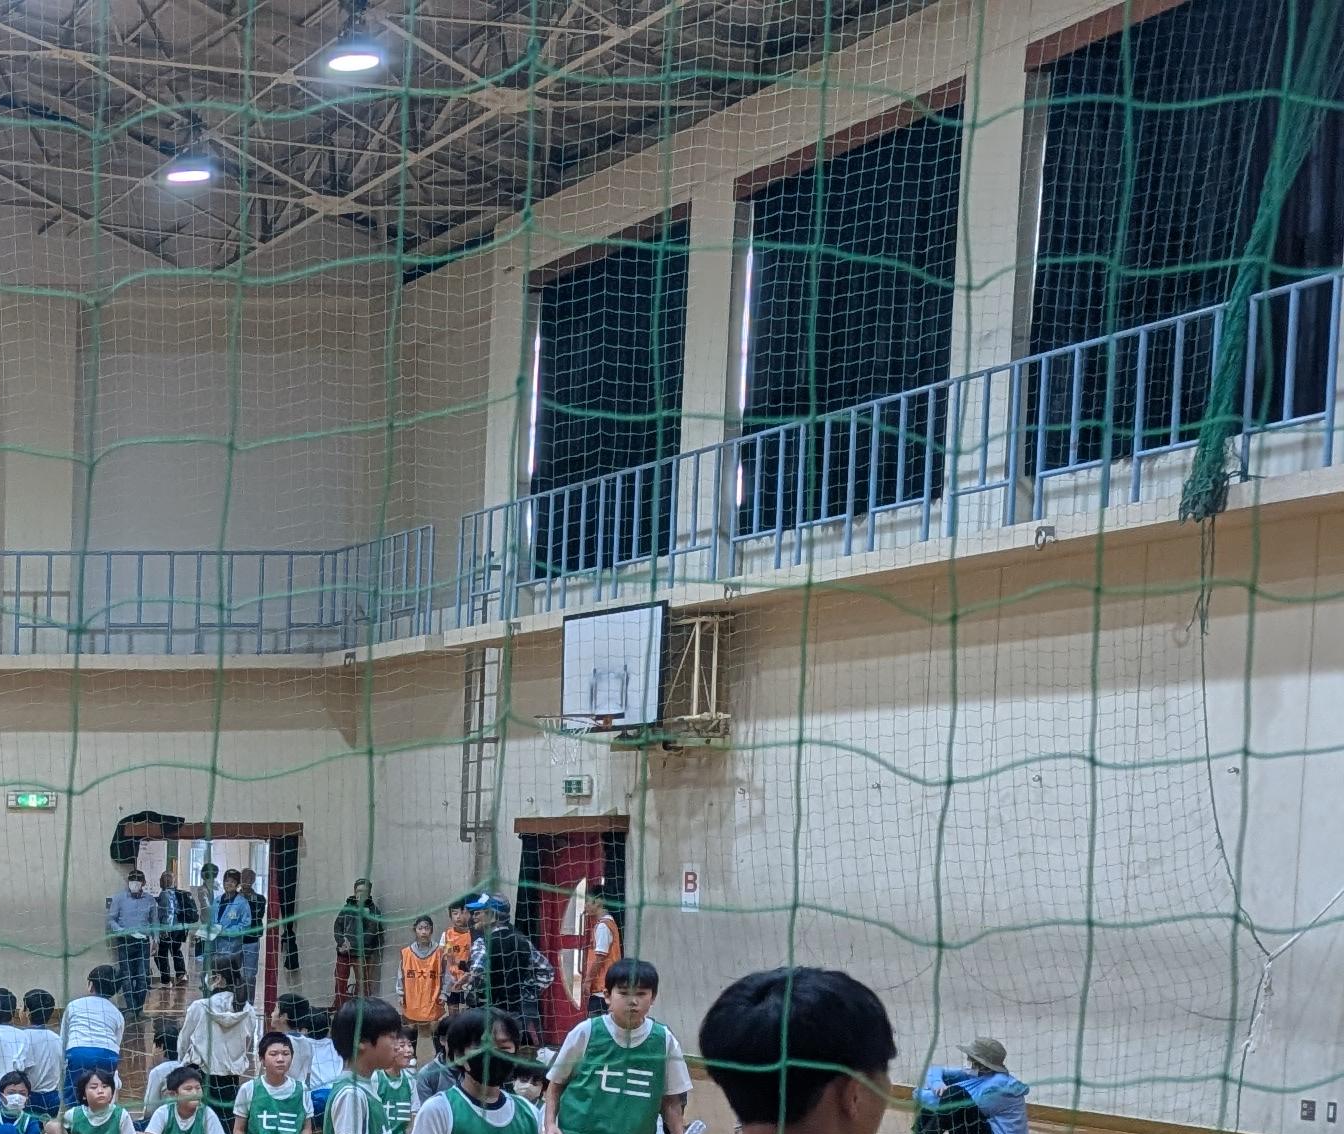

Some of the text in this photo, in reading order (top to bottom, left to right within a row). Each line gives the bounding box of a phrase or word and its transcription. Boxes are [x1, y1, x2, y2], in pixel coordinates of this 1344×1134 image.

[684, 871, 698, 893] B
[594, 1063, 654, 1098] 七三
[257, 1110, 298, 1133] 七三
